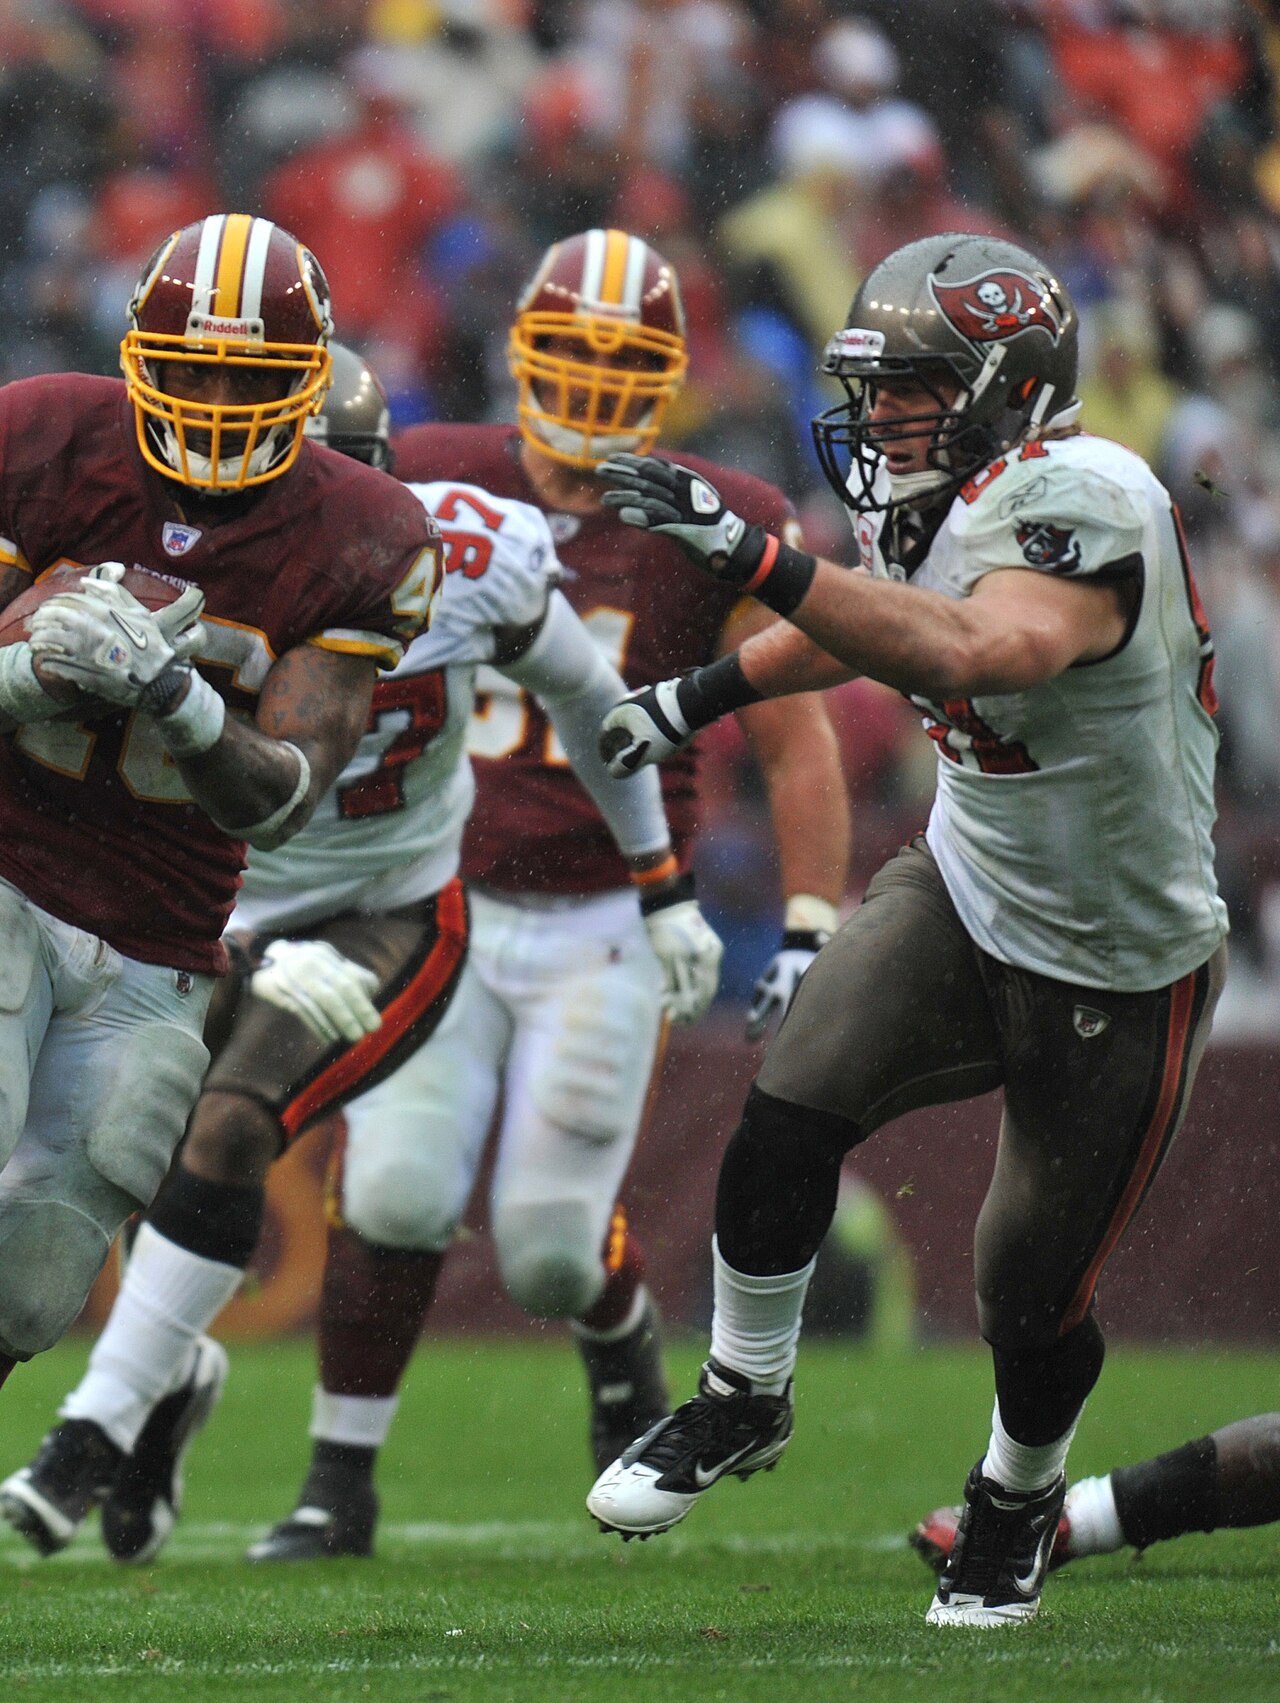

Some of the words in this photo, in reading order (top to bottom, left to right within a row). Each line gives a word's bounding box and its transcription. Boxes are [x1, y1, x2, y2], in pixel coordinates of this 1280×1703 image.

[202, 319, 249, 335] Riddell
[435, 490, 506, 580] 97
[13, 557, 278, 804] 6
